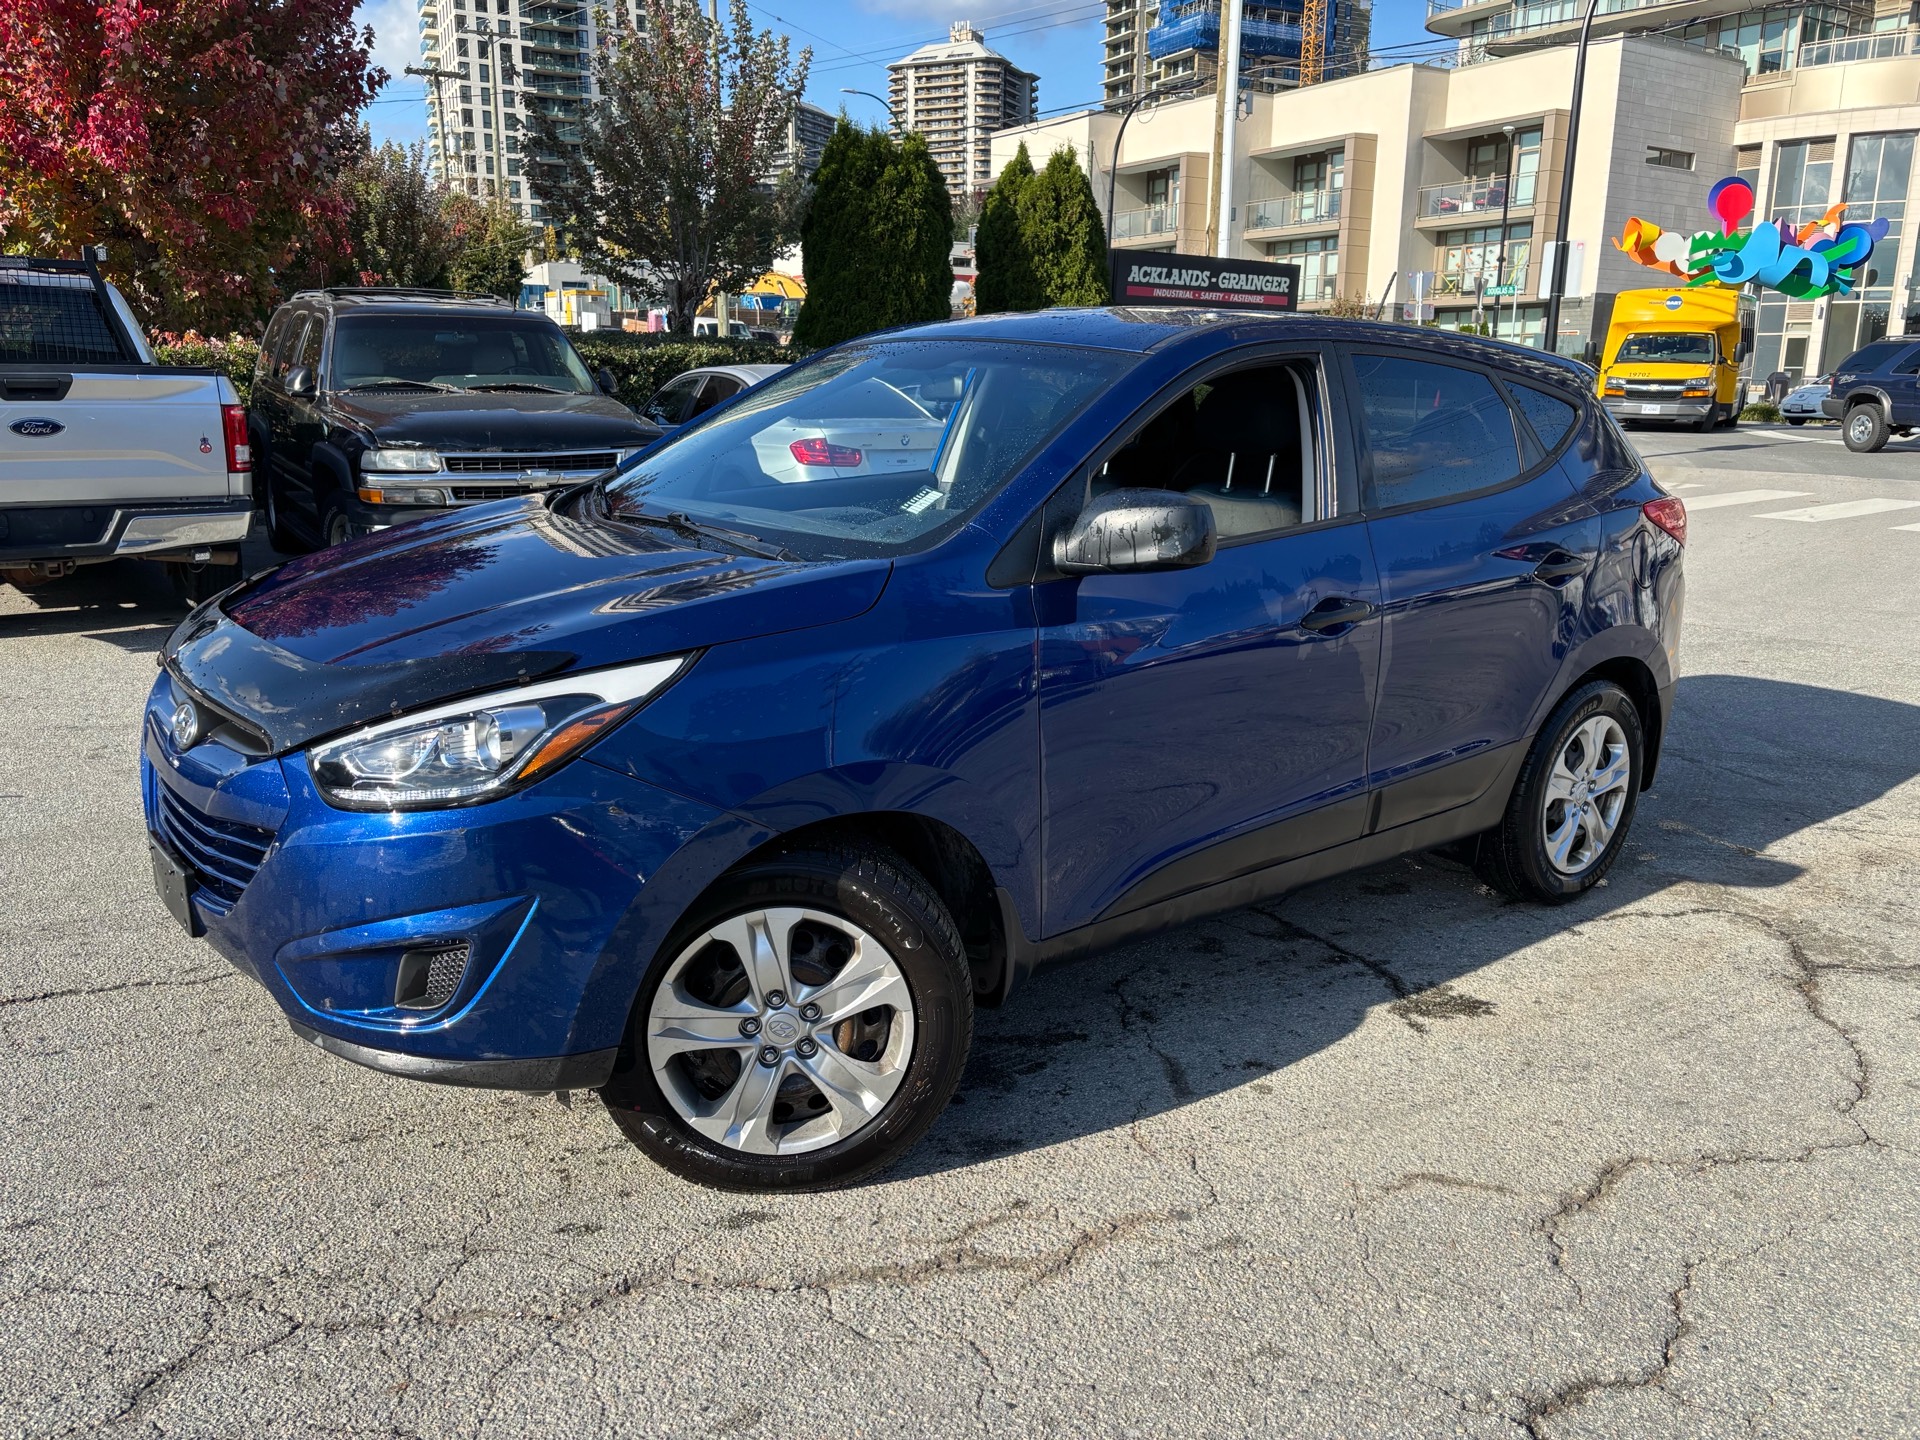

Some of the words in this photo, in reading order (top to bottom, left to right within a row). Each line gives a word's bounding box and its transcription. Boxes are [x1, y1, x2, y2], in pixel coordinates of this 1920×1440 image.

[1153, 288, 1193, 299] INDUSTRIAL
[1200, 292, 1223, 301] SAFETY
[1230, 294, 1264, 304] FASTENERS
[1487, 286, 1508, 296] DOUGLAS
[21, 421, 53, 434] Ford
